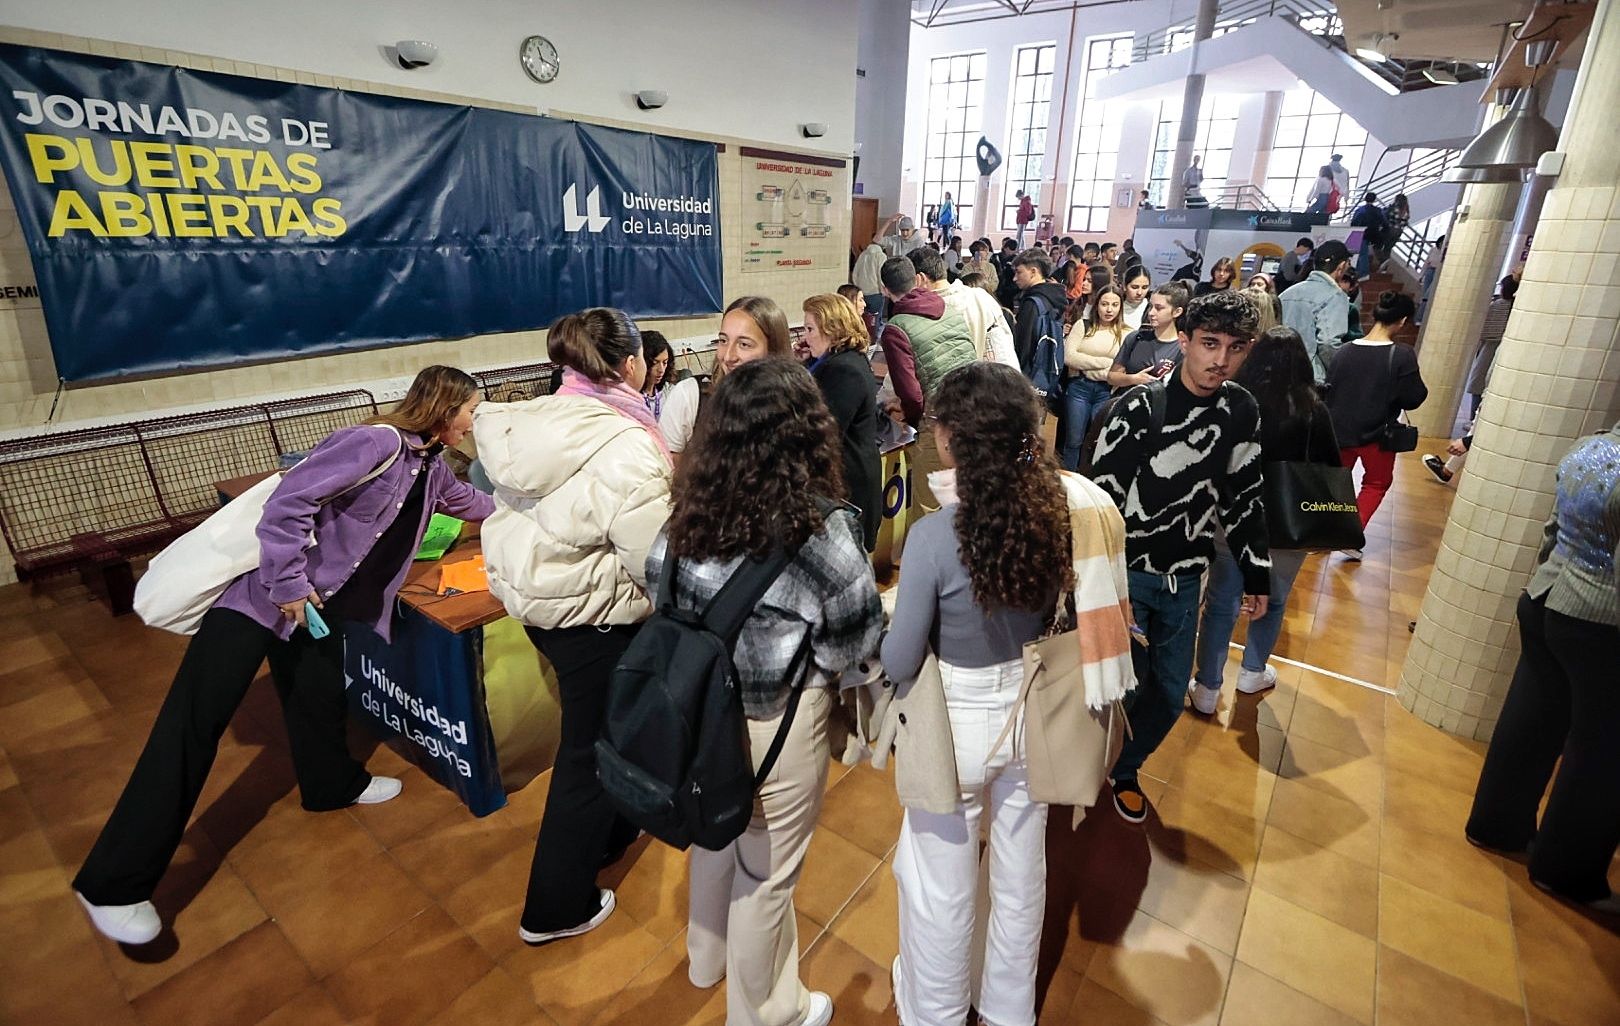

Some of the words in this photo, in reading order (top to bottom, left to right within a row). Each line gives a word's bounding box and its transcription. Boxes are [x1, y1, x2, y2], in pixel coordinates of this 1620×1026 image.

[13, 90, 271, 144] JORNADAS
[281, 118, 332, 149] DE
[24, 133, 323, 194] PUERTAS
[48, 190, 348, 238] ABIERTAS
[622, 191, 712, 214] Universidad
[622, 216, 644, 234] de
[647, 218, 663, 235] La
[664, 219, 713, 240] Laguna
[1300, 501, 1328, 512] Calvin
[361, 654, 468, 745] Universidad
[361, 689, 380, 717] de
[383, 702, 402, 733] La
[403, 718, 472, 778] Laguna
